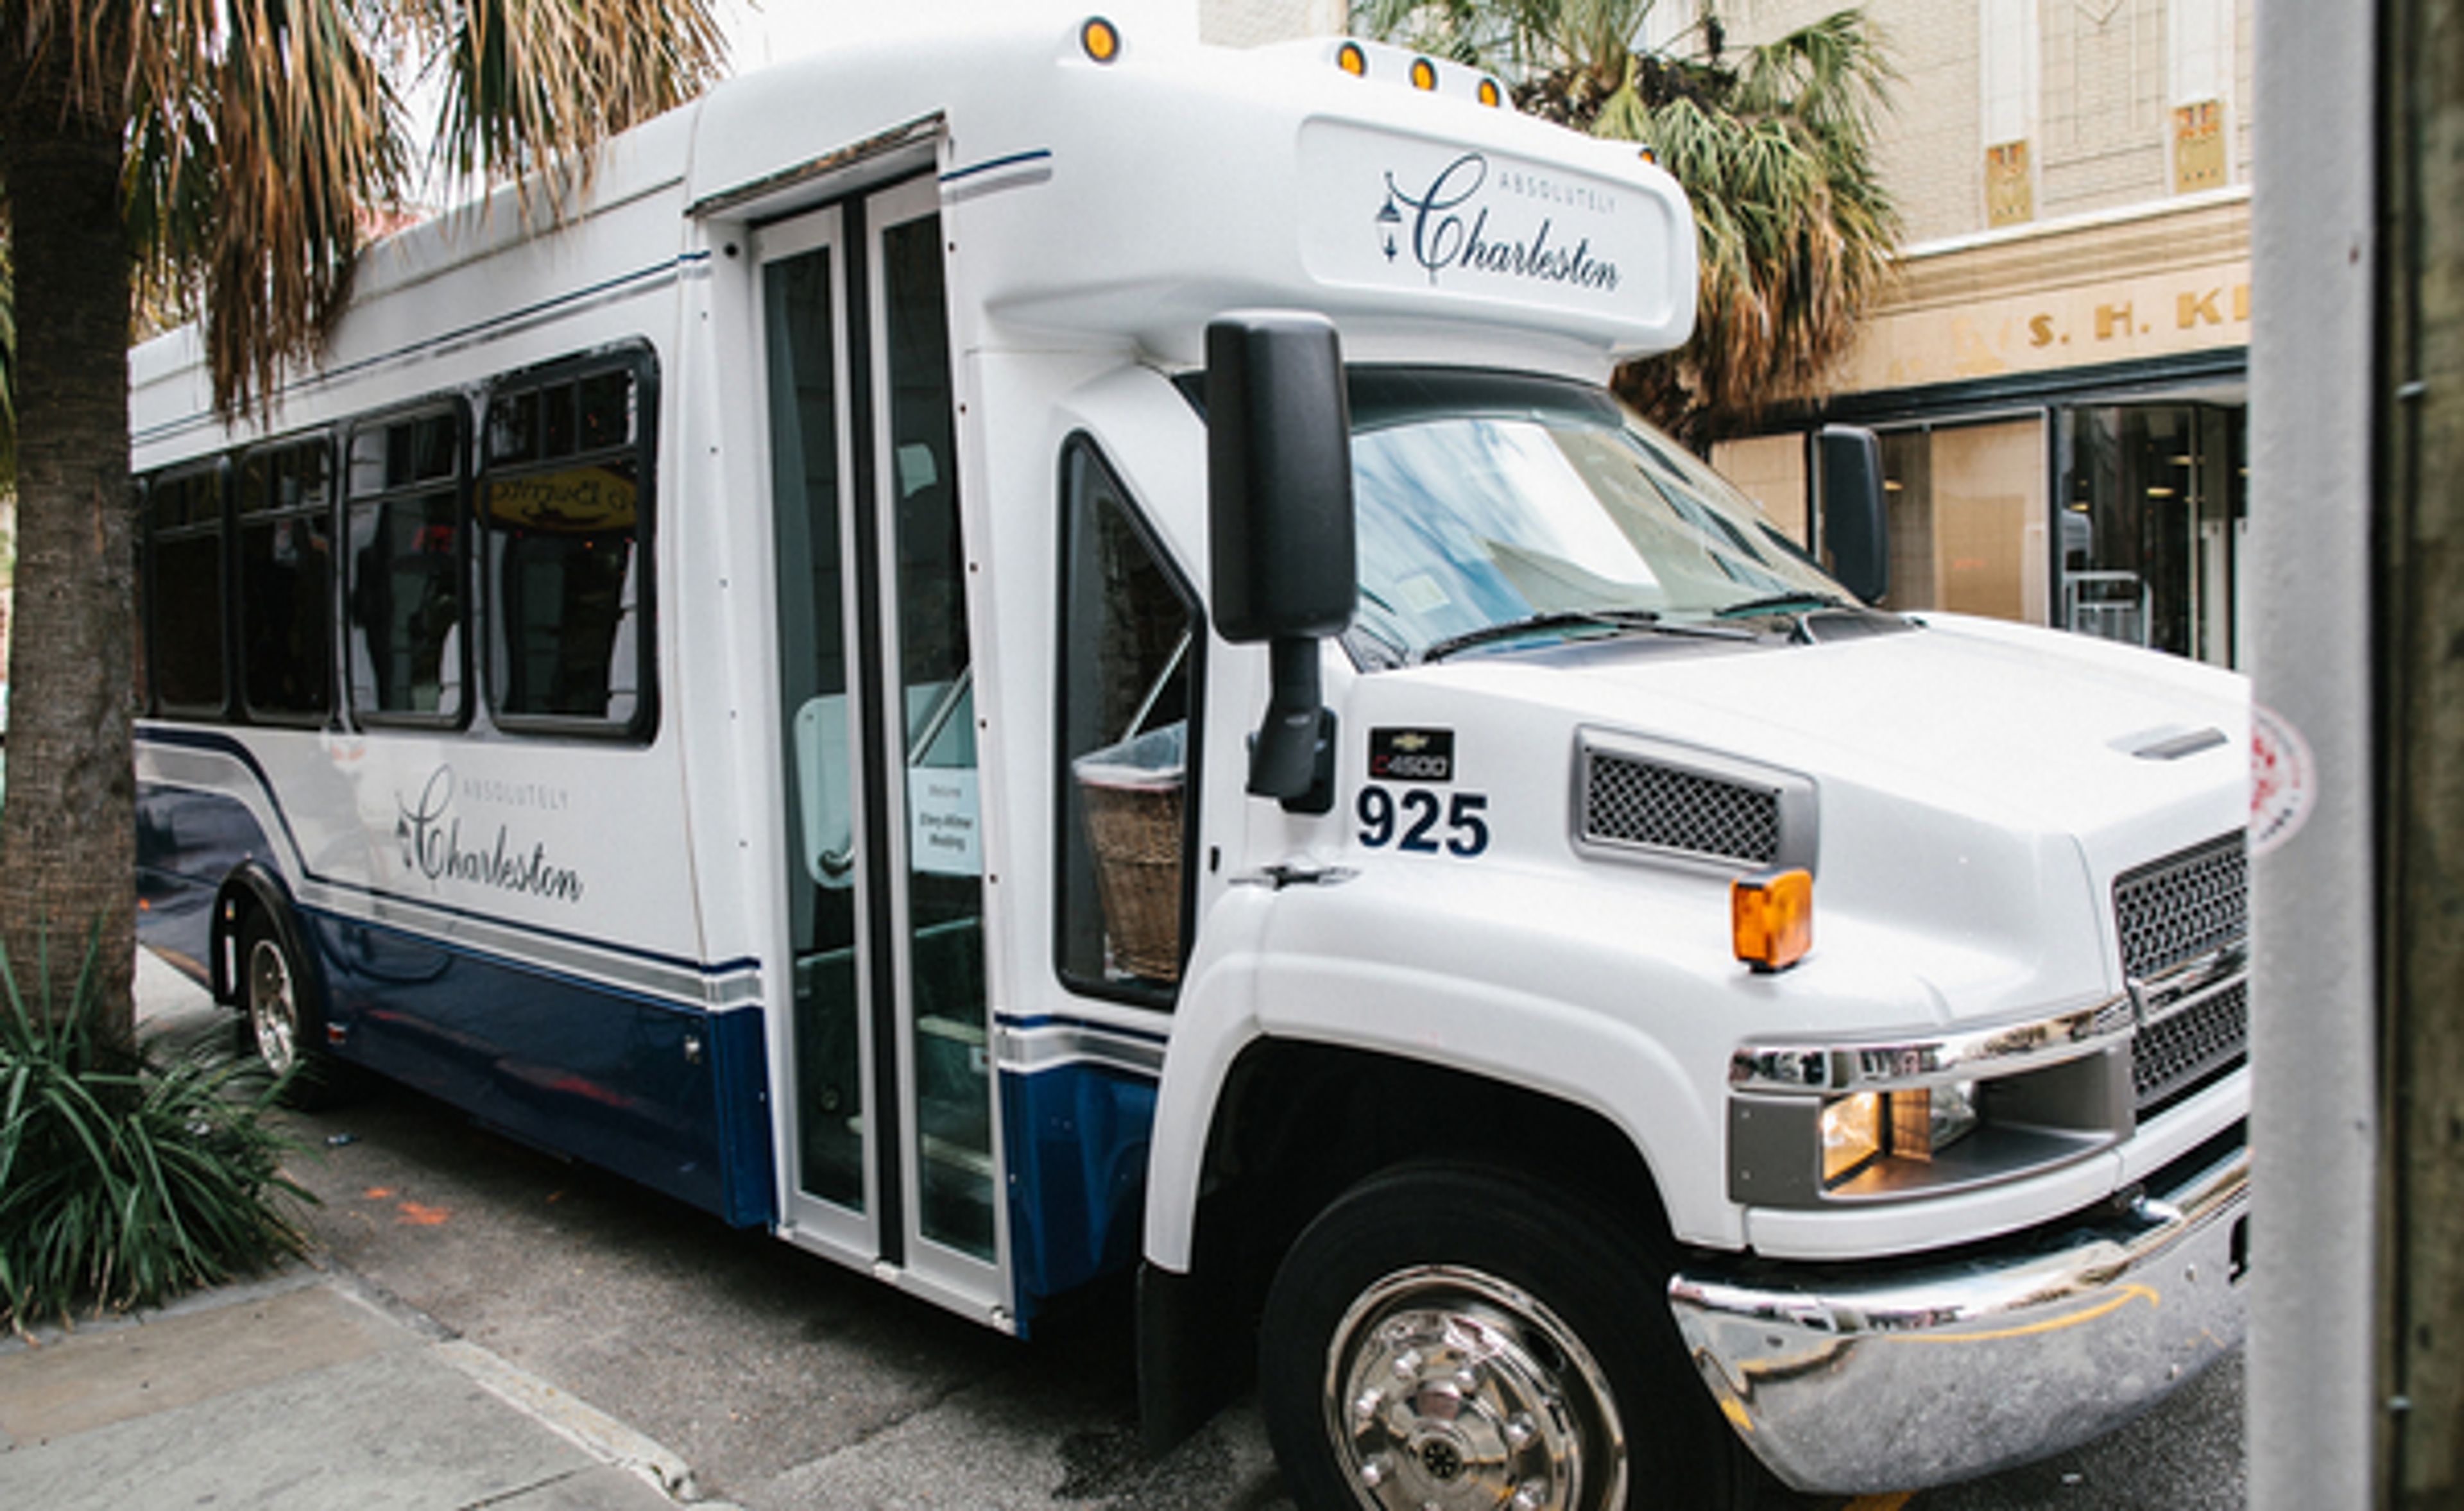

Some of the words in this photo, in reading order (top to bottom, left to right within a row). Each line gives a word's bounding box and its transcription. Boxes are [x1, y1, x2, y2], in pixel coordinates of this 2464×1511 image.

[1384, 151, 1620, 290] Charleston
[1500, 171, 1616, 214] ABSOLUTELY
[2028, 312, 2070, 347] S.
[2094, 300, 2150, 341] H.
[463, 776, 570, 810] ABSOLUTELY
[1356, 785, 1489, 858] 925
[395, 763, 585, 903] Charleston
